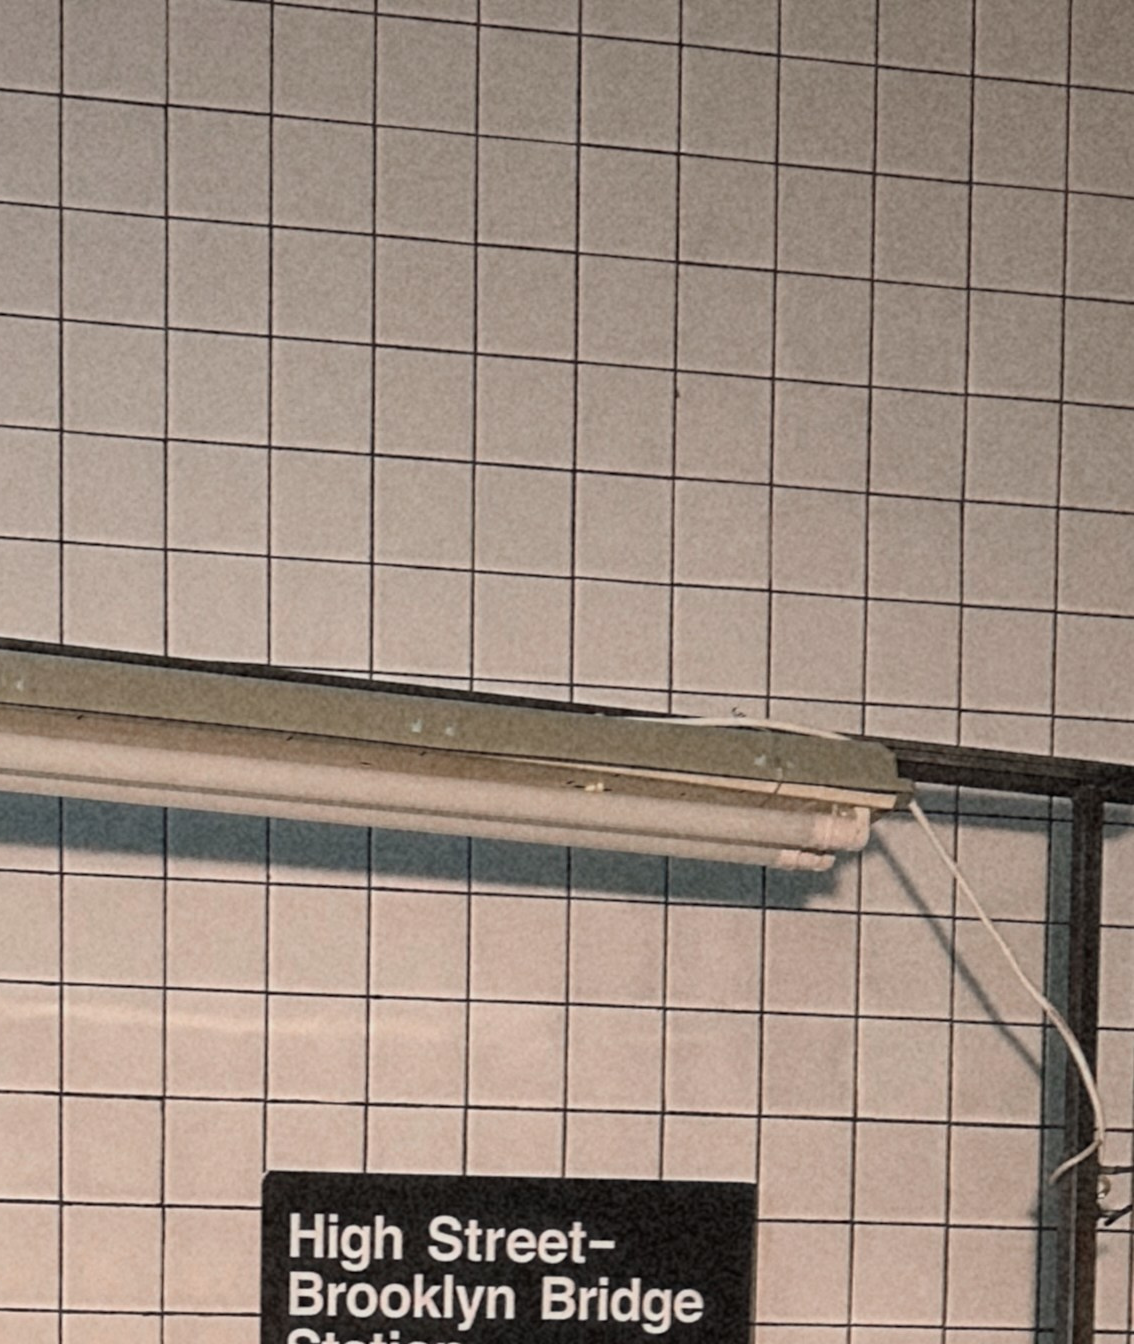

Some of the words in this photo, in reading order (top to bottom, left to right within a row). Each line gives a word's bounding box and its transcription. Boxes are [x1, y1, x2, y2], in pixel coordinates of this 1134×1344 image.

[289, 1212, 403, 1272] High
[289, 1271, 515, 1331] Brooklyn
[541, 1276, 704, 1335] Bridge
